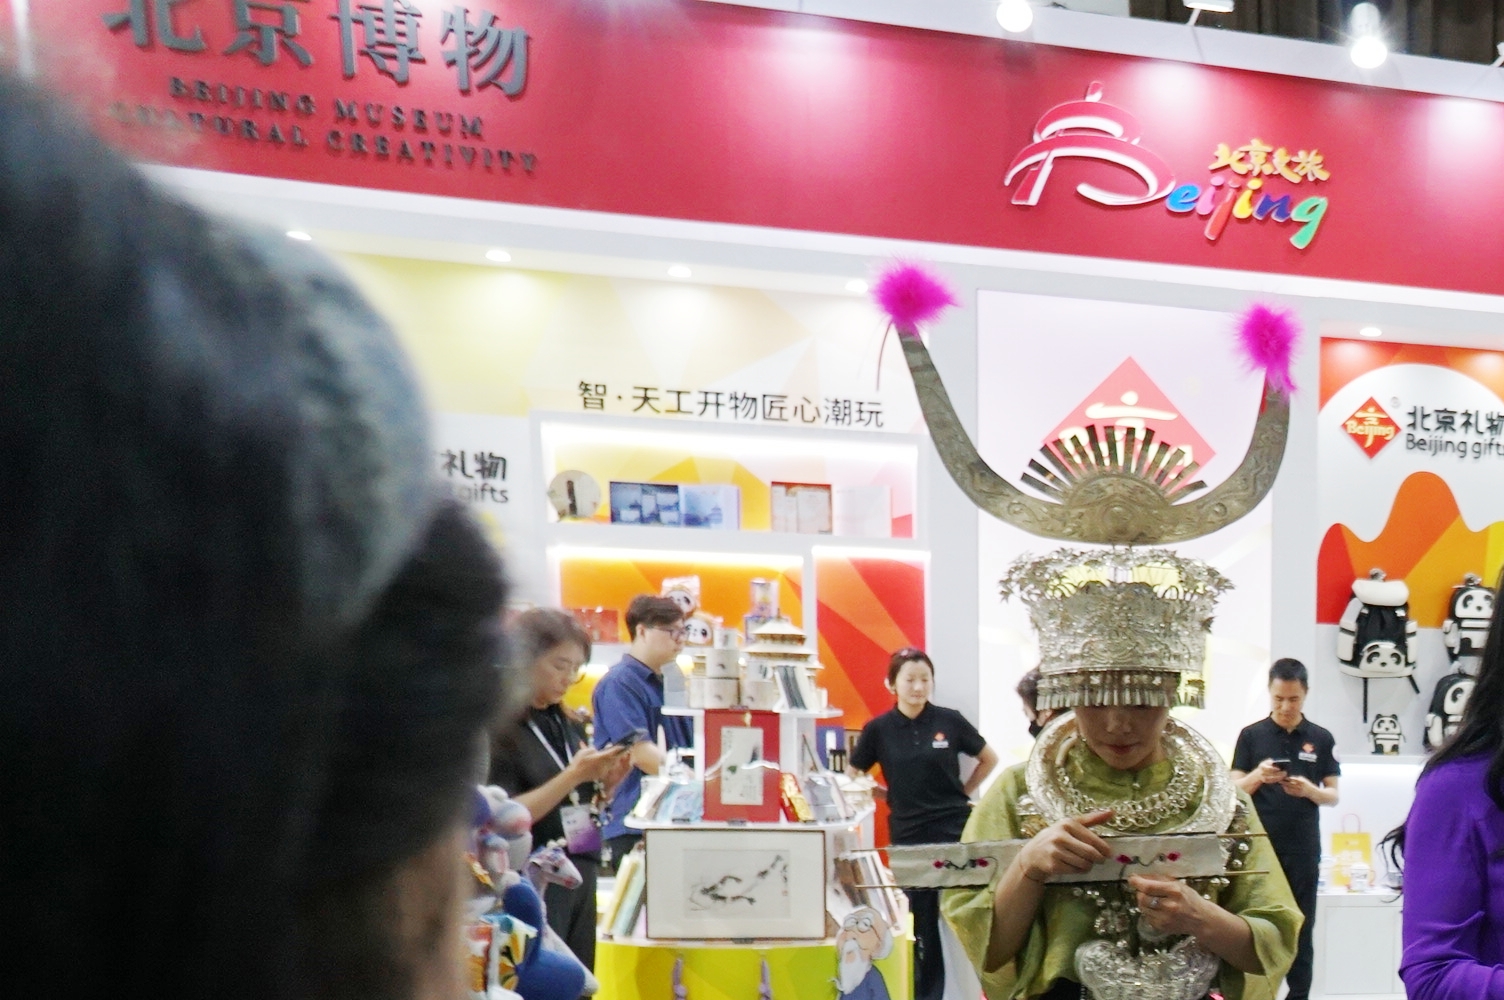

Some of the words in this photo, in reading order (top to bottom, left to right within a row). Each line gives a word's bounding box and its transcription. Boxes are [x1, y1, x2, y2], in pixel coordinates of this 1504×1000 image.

[169, 77, 315, 115] BEIJING
[336, 98, 484, 138] MUSEUM
[327, 130, 537, 174] CREATIVITY
[1405, 433, 1468, 458] Beijing
